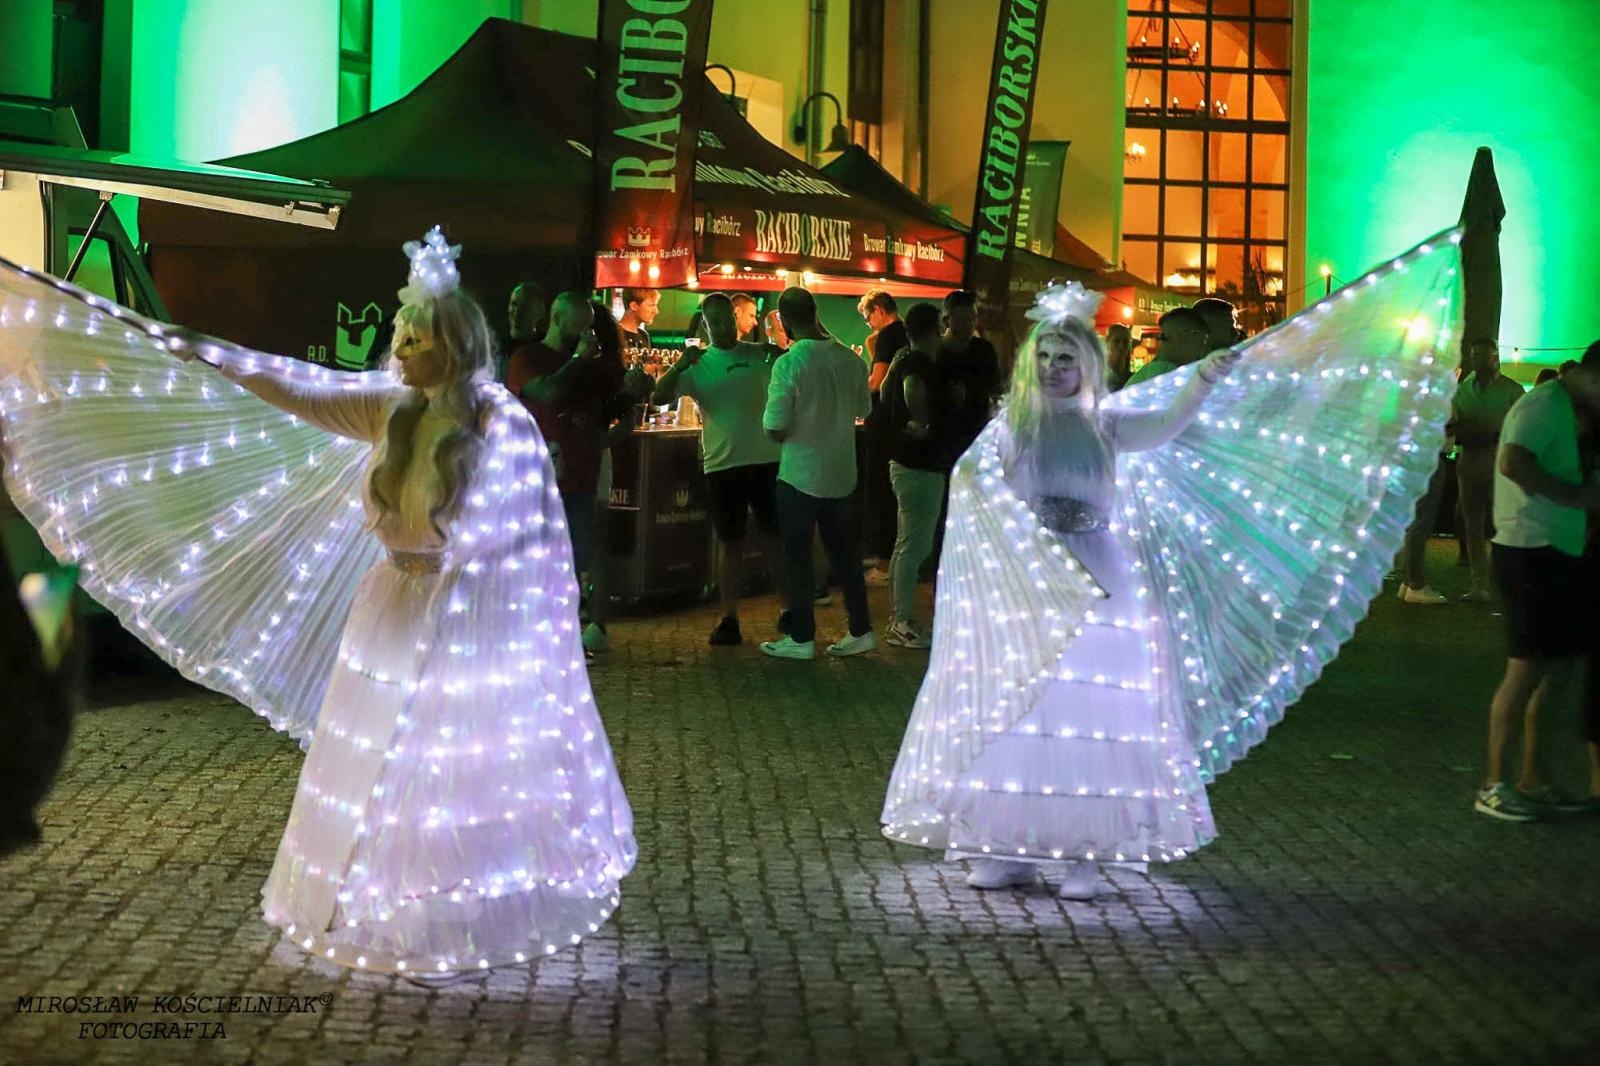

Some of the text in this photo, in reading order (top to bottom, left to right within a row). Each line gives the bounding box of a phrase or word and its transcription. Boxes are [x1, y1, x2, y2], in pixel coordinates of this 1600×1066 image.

[755, 209, 852, 261] RACIBORSKIE
[863, 233, 886, 253] Browar
[916, 240, 945, 262] Racibórz
[619, 248, 657, 260] Zamkowy
